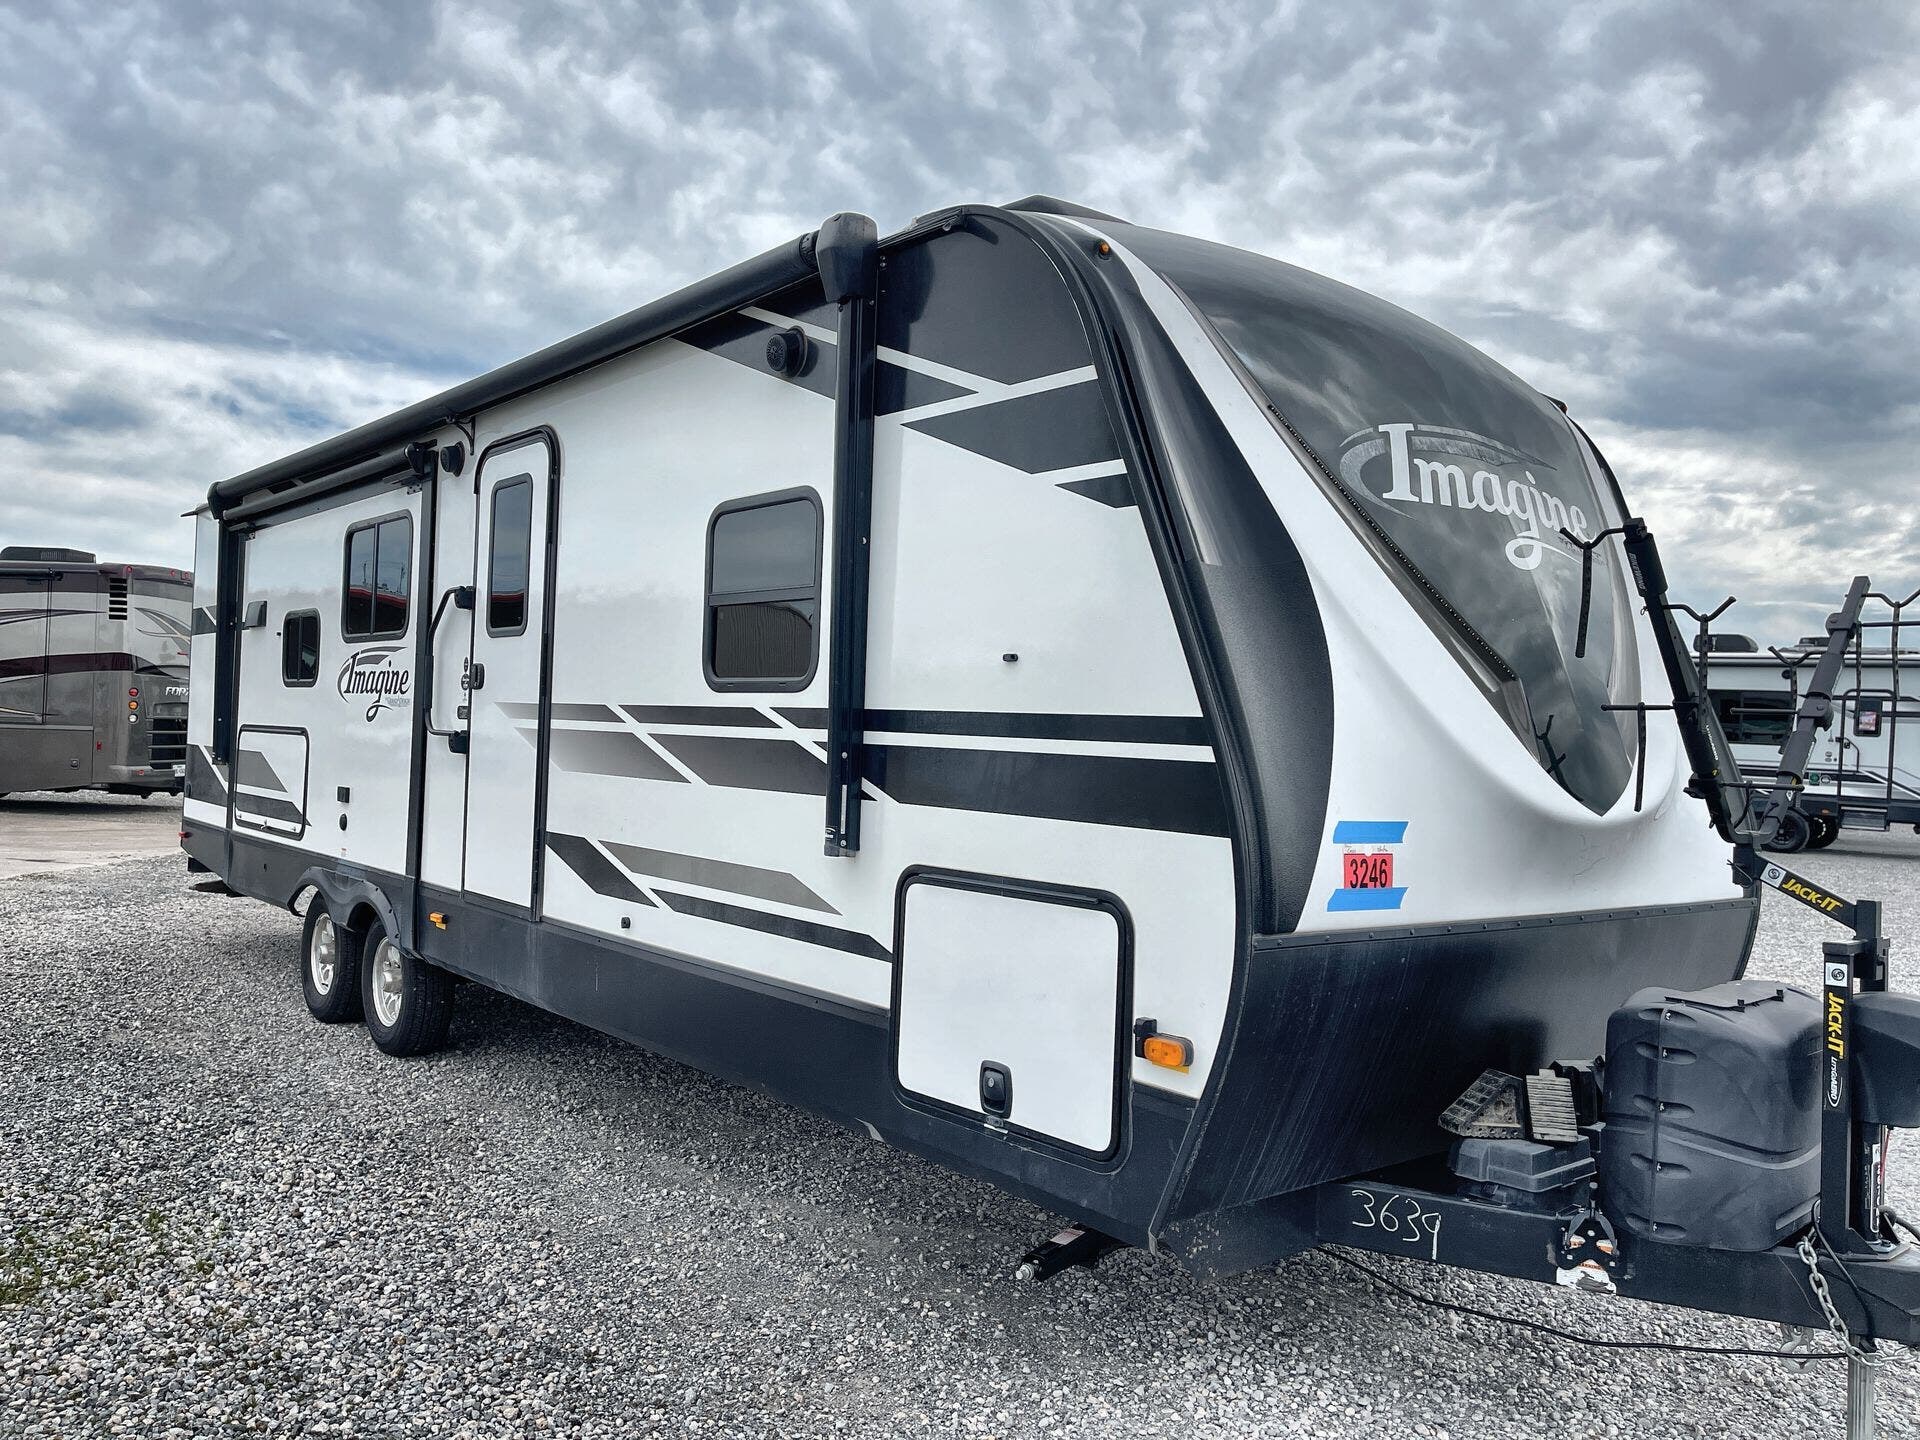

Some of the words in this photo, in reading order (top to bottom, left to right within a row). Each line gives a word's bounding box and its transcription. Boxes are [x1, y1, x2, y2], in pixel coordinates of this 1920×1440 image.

[1378, 423, 1597, 570] Imagine
[343, 651, 411, 722] Imagine
[1349, 858, 1388, 889] 3246
[1782, 878, 1842, 912] JACK-IT
[1825, 991, 1844, 1057] JACK-IT
[1351, 1189, 1442, 1261] 3639
